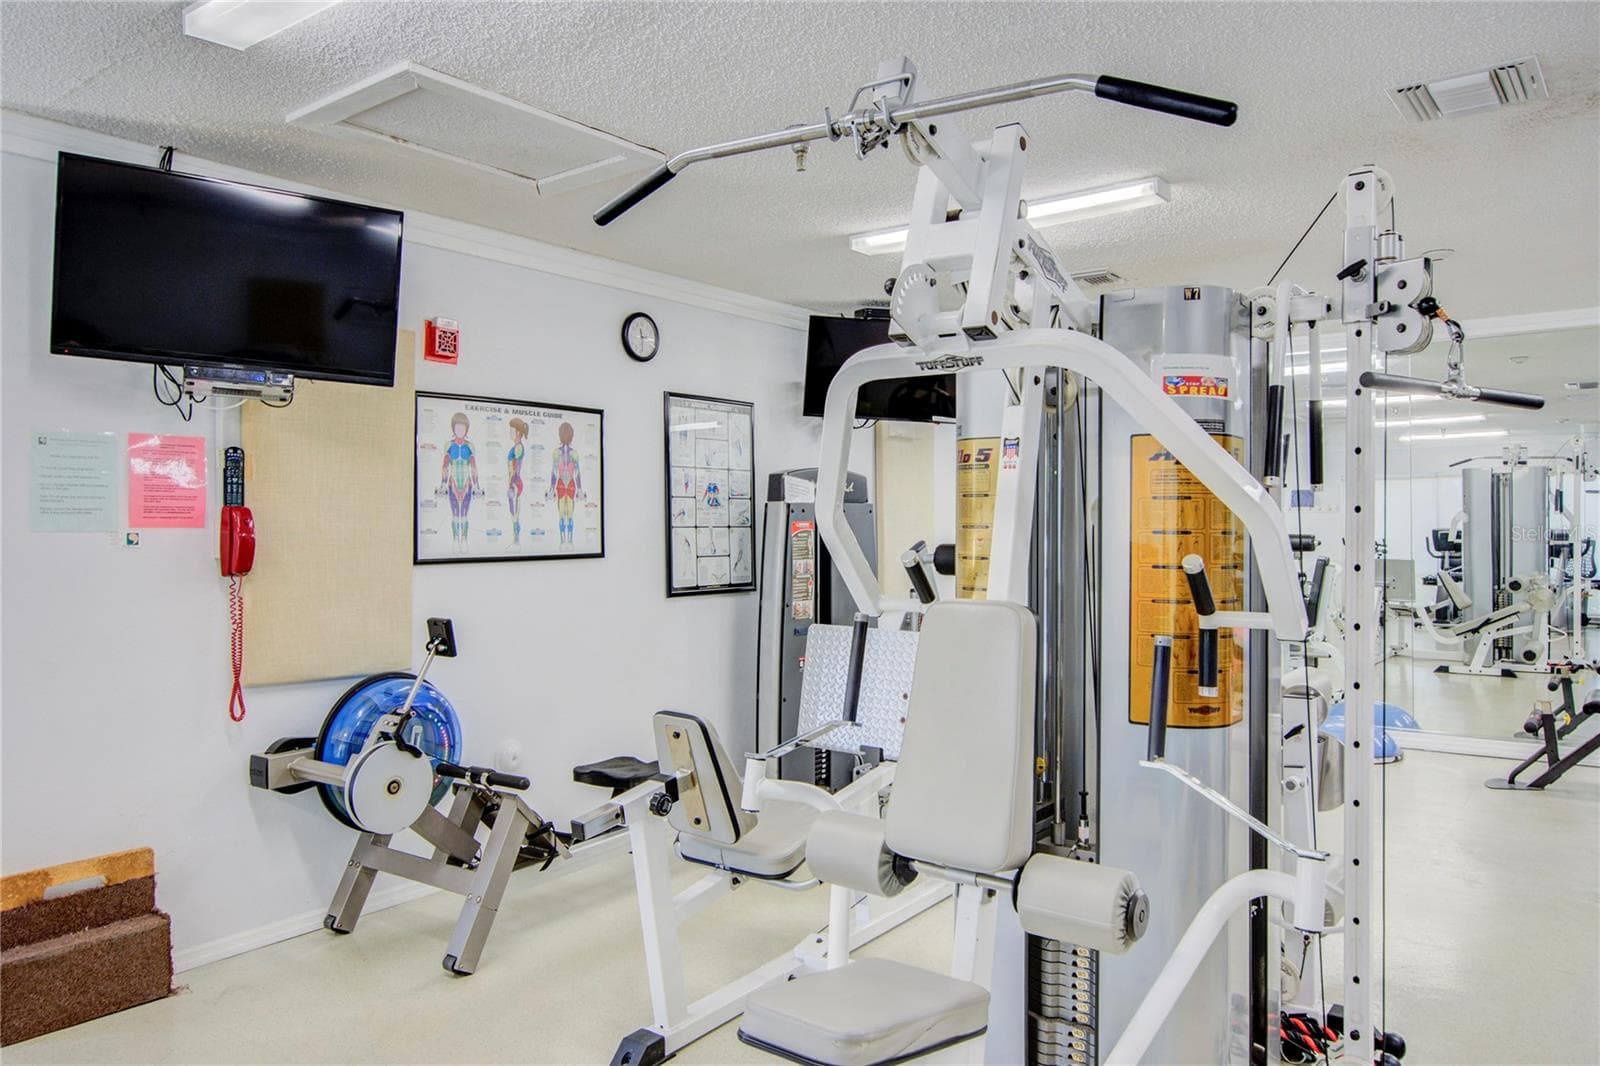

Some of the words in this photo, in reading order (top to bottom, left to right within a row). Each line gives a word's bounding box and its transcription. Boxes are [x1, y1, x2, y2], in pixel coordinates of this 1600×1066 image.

[1167, 384, 1226, 396] SPREAD
[512, 409, 540, 418] MUSCLE
[542, 412, 563, 420] GUIDE
[975, 448, 993, 463] 5
